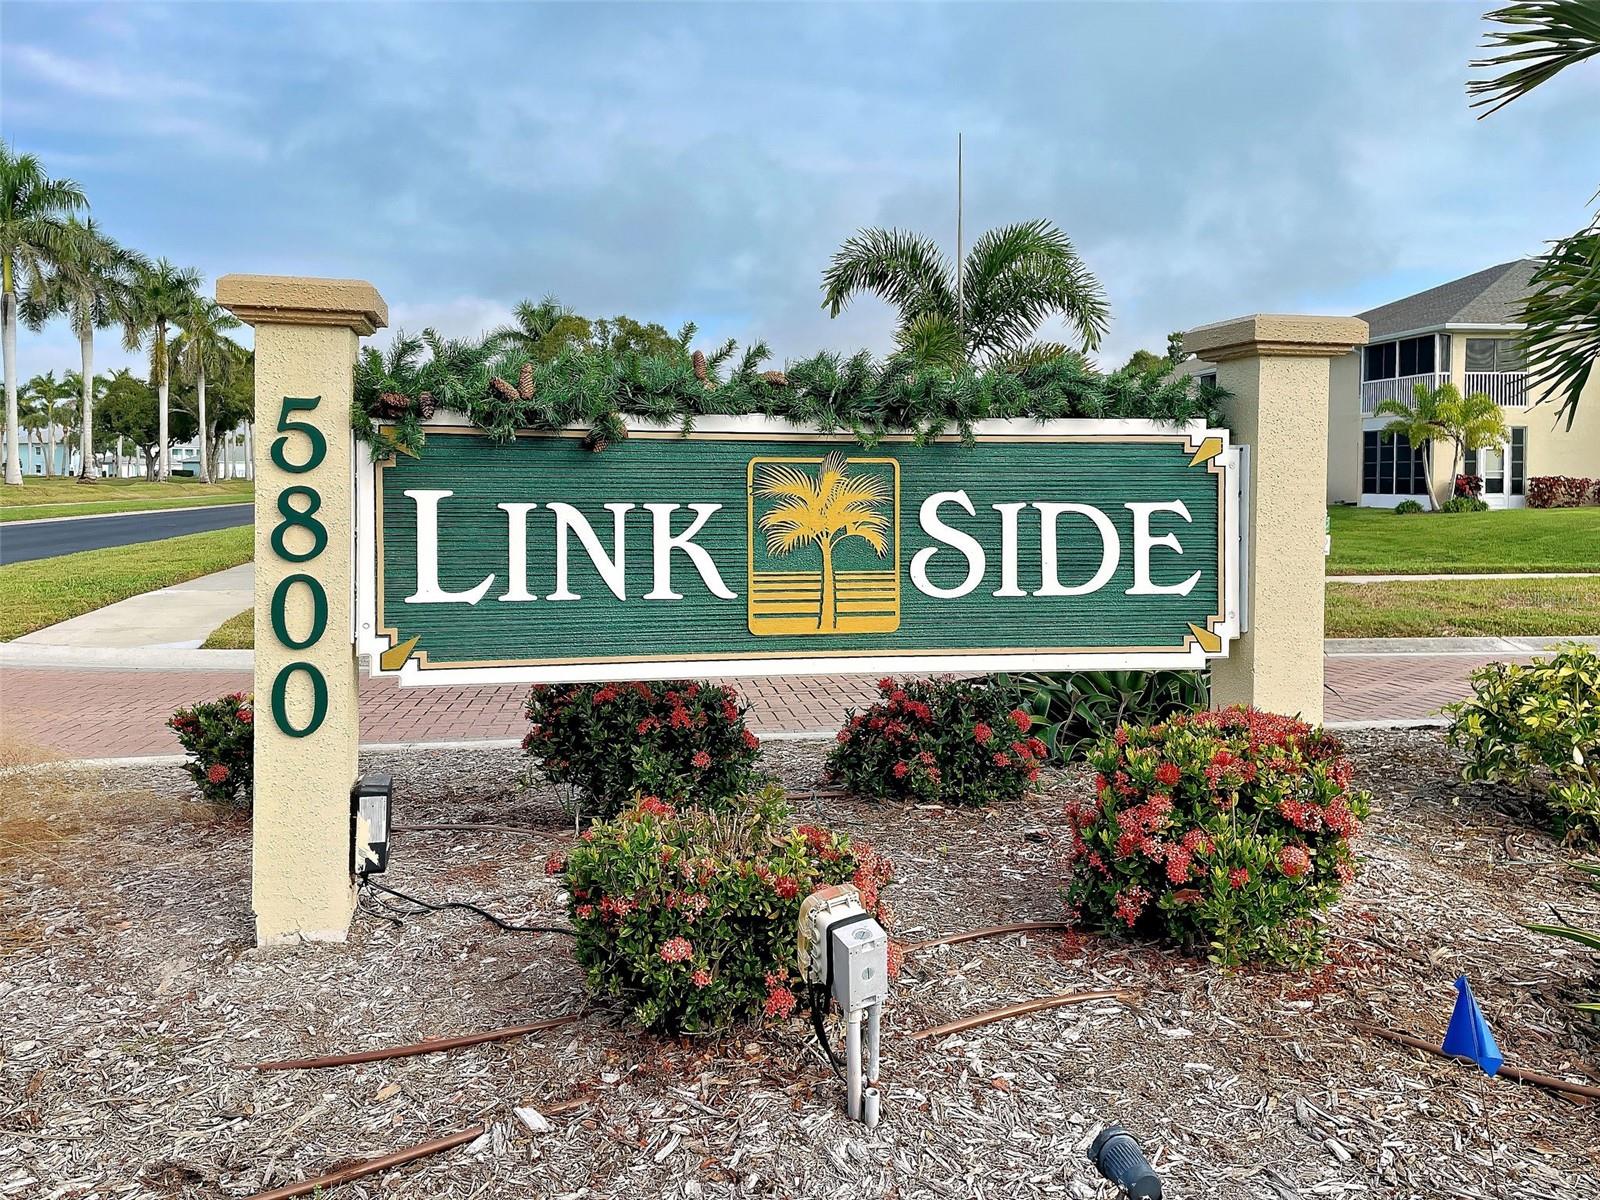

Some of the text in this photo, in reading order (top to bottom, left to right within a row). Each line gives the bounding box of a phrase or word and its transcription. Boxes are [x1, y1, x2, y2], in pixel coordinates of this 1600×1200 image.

[270, 395, 329, 739] 5800
[403, 489, 1202, 606] LINK SIDE
